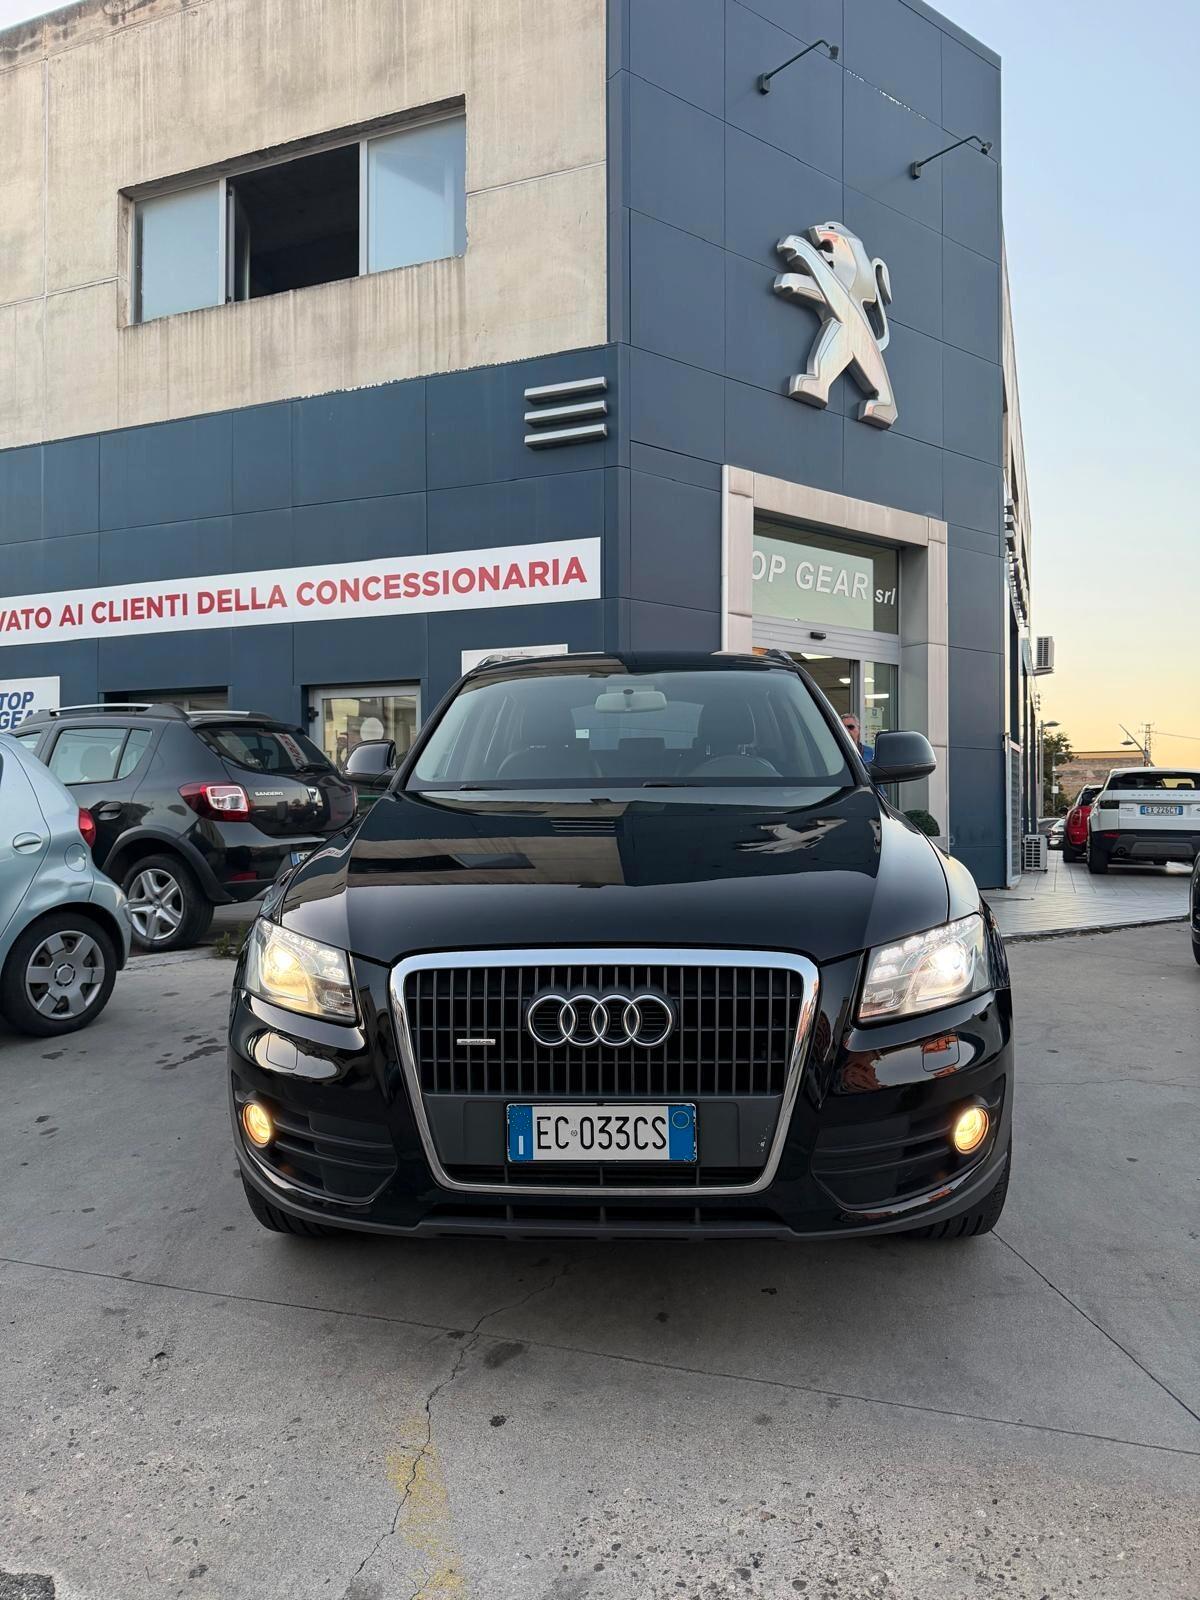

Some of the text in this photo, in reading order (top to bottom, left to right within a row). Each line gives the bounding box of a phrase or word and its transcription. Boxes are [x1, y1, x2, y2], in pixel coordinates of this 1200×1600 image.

[59, 603, 83, 627] AI
[91, 593, 188, 624] CLIENTI
[197, 584, 288, 615] DELLA
[296, 556, 588, 607] CONCESSIONARIA
[795, 562, 869, 600] GEAR
[874, 588, 896, 605] srl
[0, 691, 34, 710] TOP
